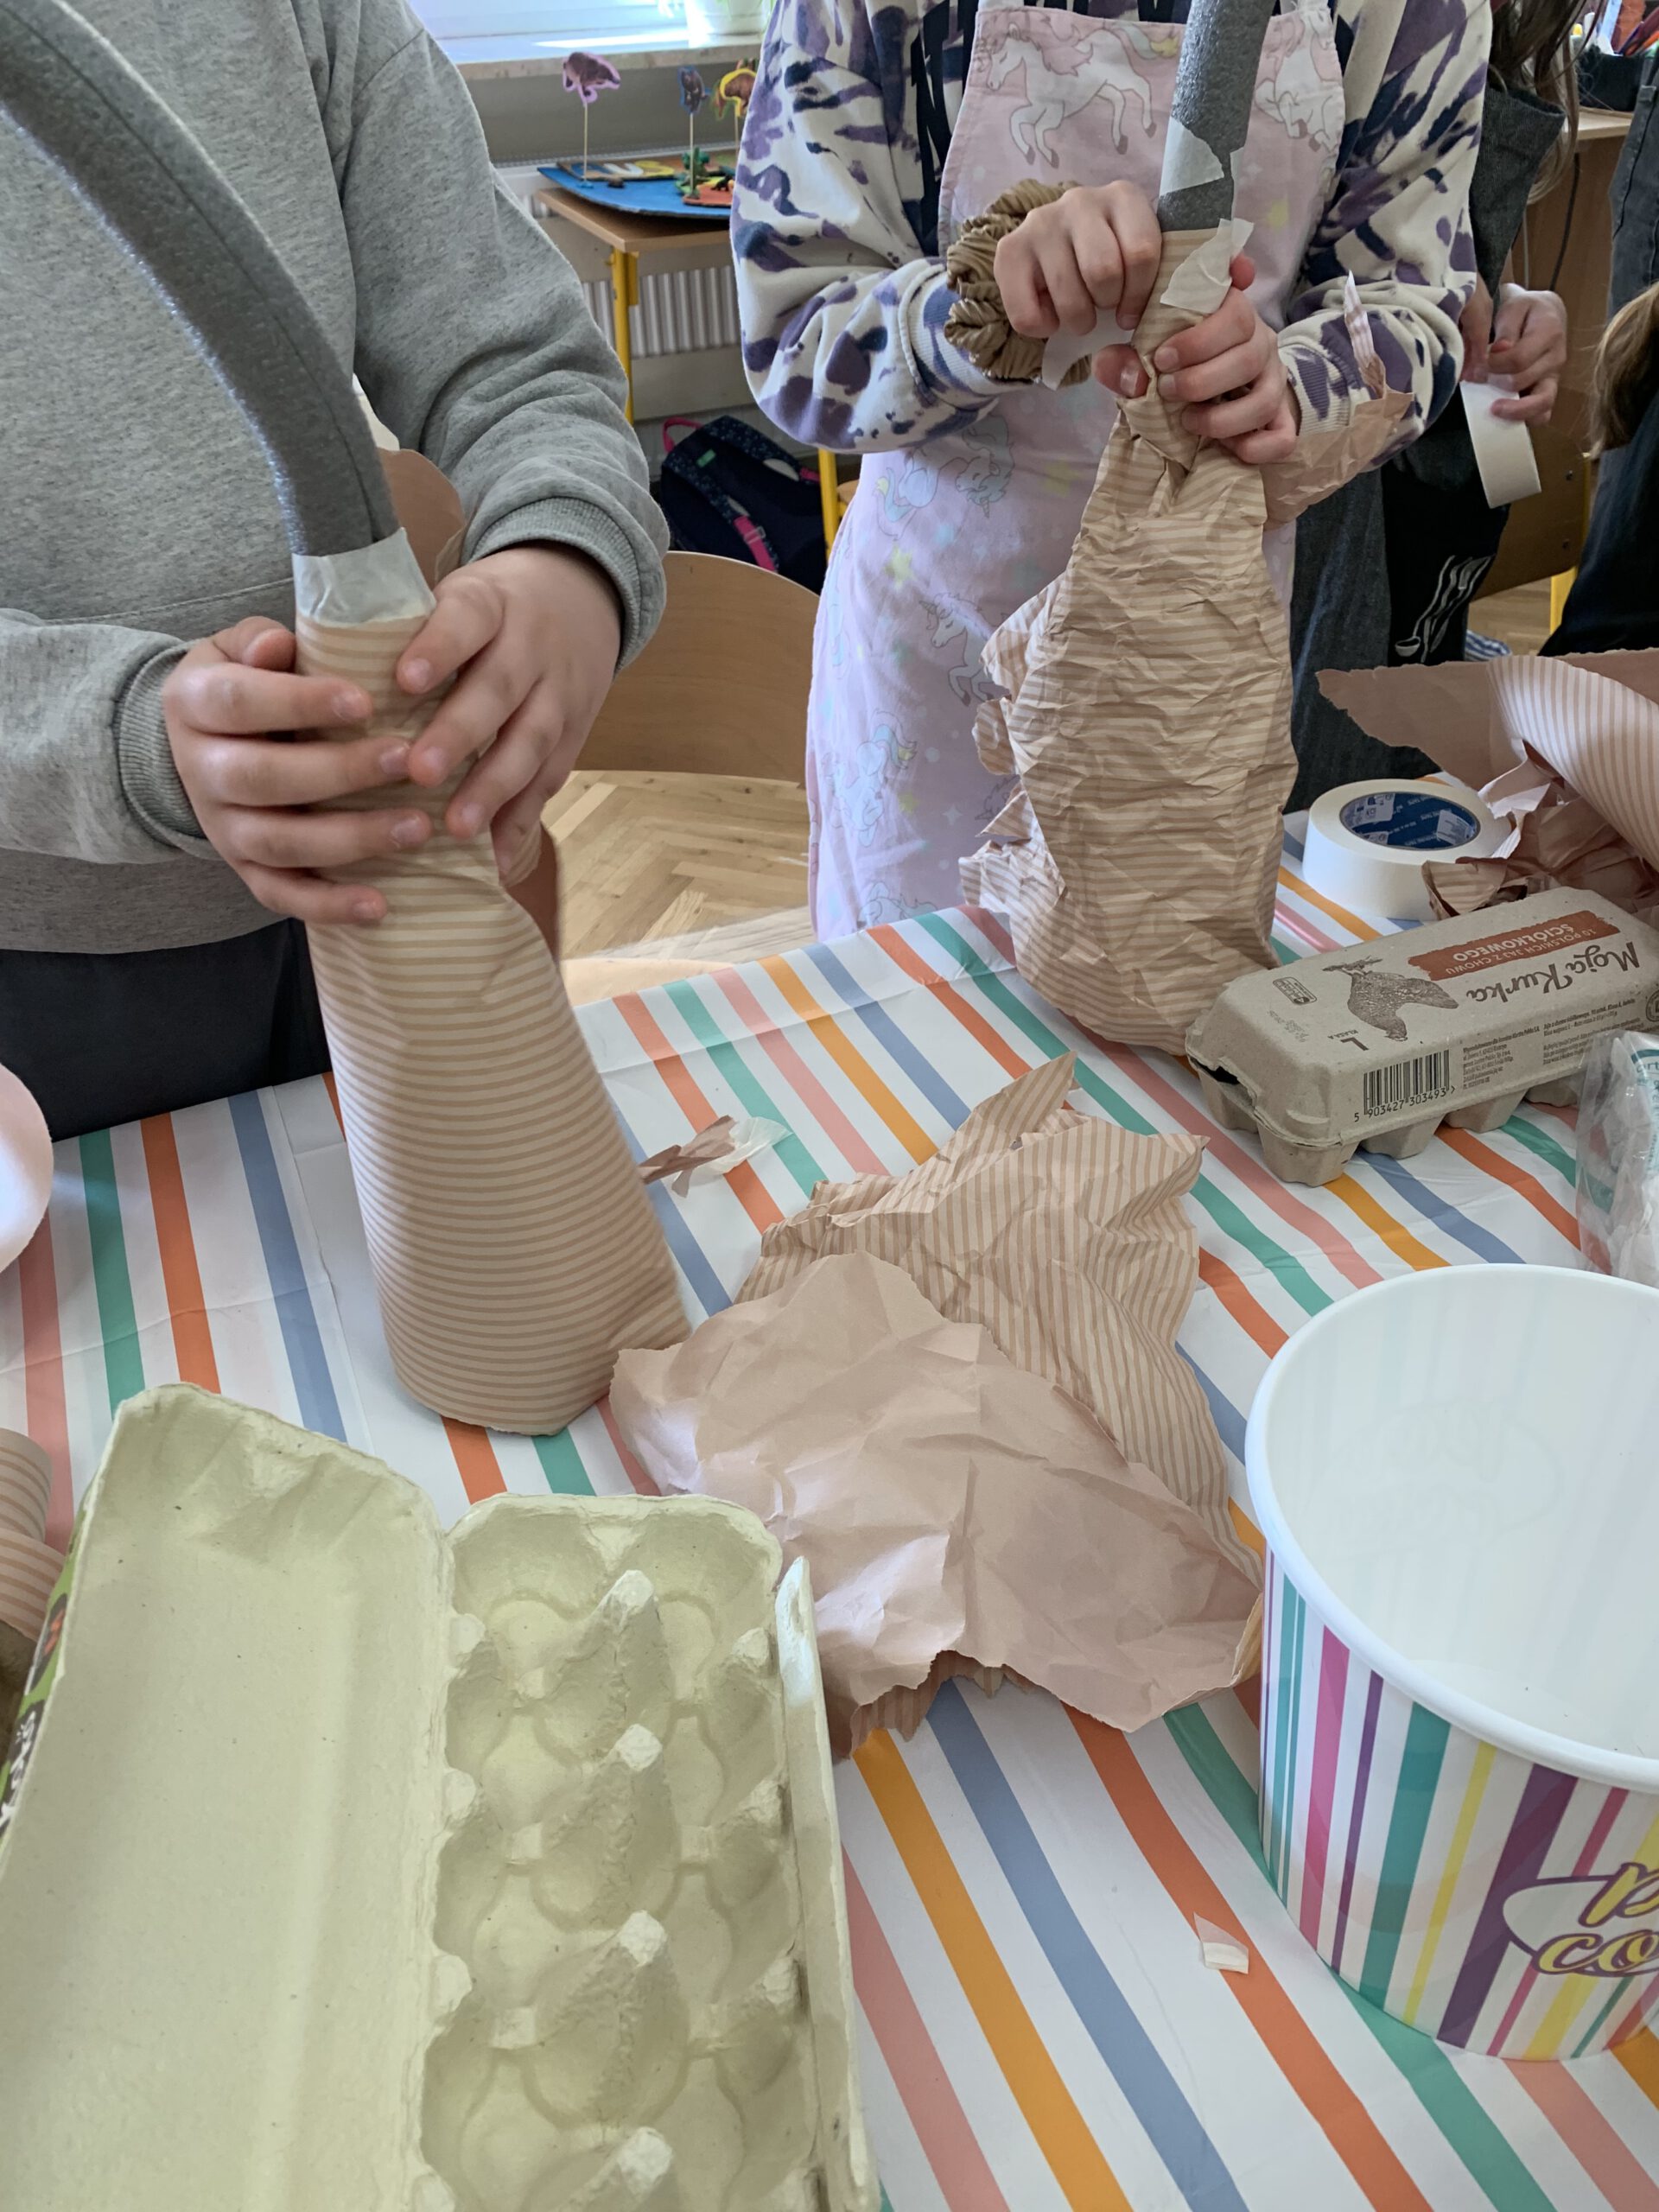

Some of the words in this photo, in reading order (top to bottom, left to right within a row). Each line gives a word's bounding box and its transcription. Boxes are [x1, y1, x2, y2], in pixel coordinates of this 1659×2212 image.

[1452, 924, 1574, 963] ŚCIÓŁKOWEGO
[1528, 931, 1582, 953] POLSKICH
[1586, 928, 1597, 938] 10
[1445, 957, 1492, 975] CHOWU
[1503, 949, 1524, 961] JAJ
[1566, 941, 1640, 974] Moja
[1466, 963, 1573, 1003] Kurka
[1354, 1112, 1360, 1122] 5
[1368, 1100, 1405, 1118] 903427
[1409, 1087, 1447, 1107] 303493
